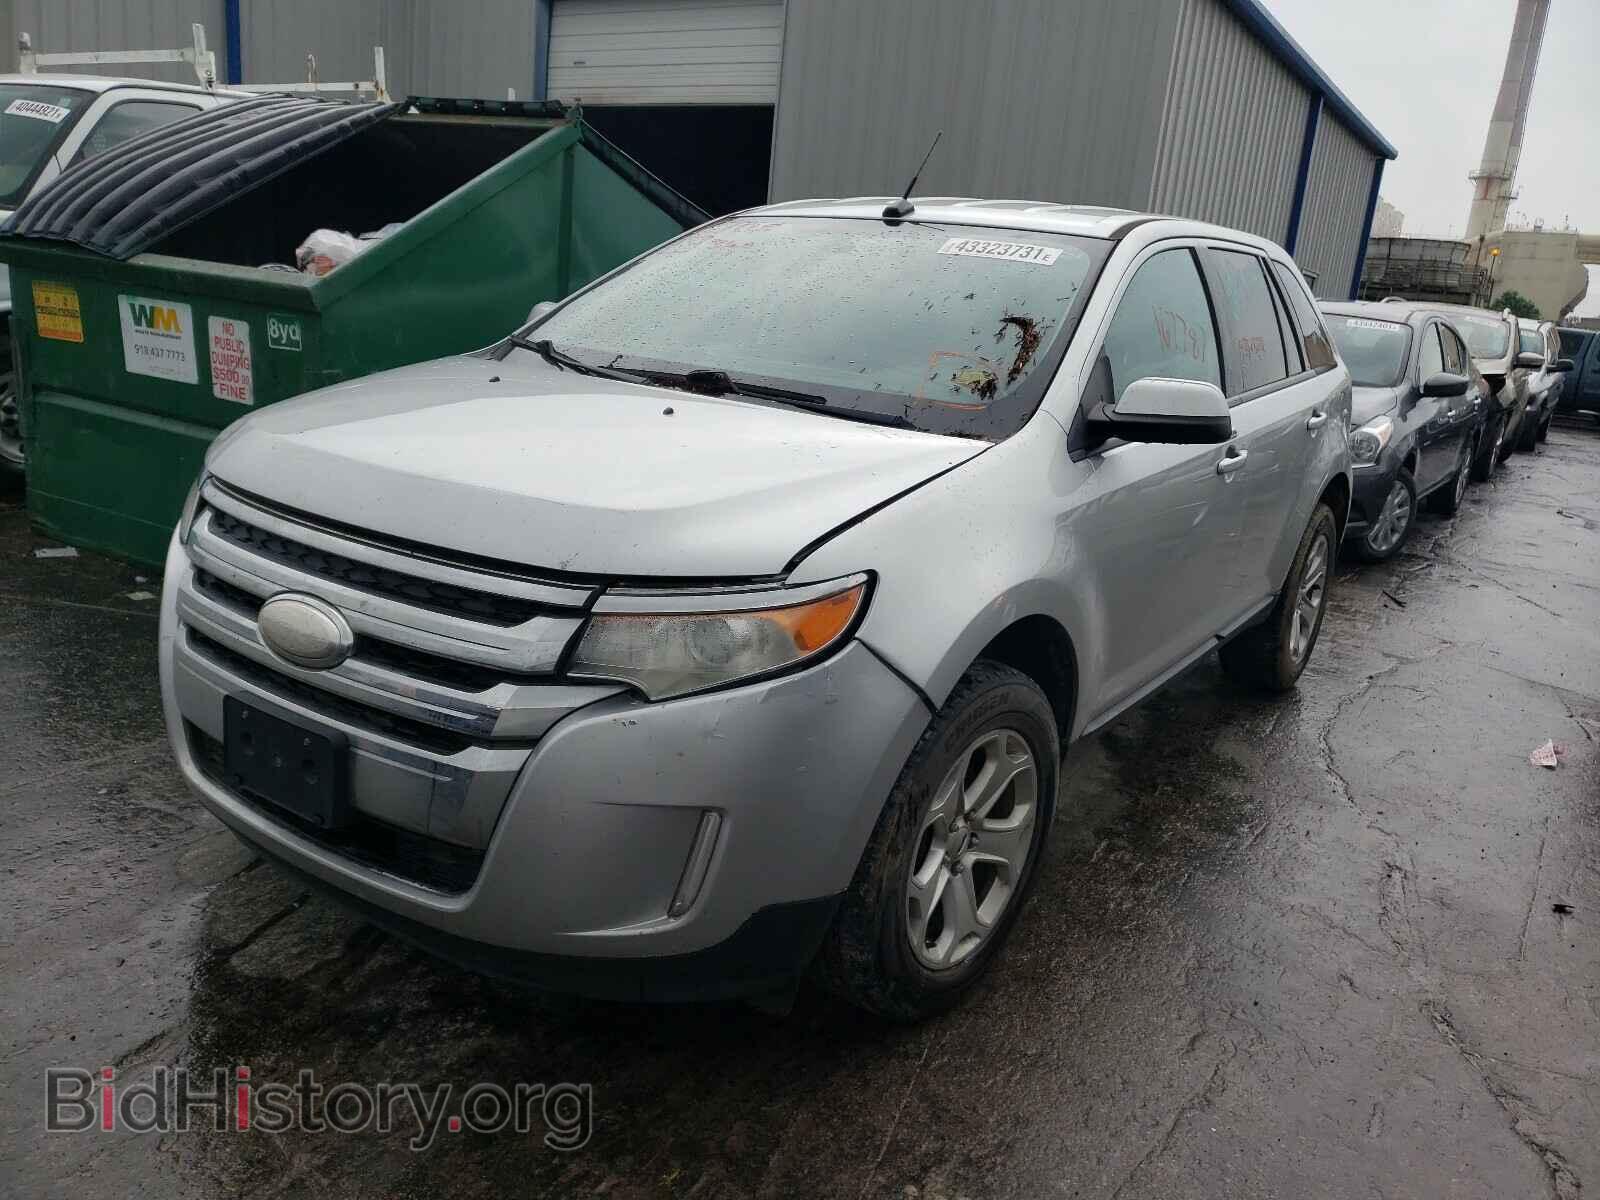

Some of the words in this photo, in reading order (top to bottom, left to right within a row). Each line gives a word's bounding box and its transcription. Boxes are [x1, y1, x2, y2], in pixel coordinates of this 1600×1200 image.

[128, 302, 183, 335] WM
[223, 321, 234, 337] NO
[269, 318, 300, 344] 8yd
[213, 335, 244, 353] PUBLIC
[211, 351, 250, 370] DUMPING
[220, 383, 246, 400] FINE
